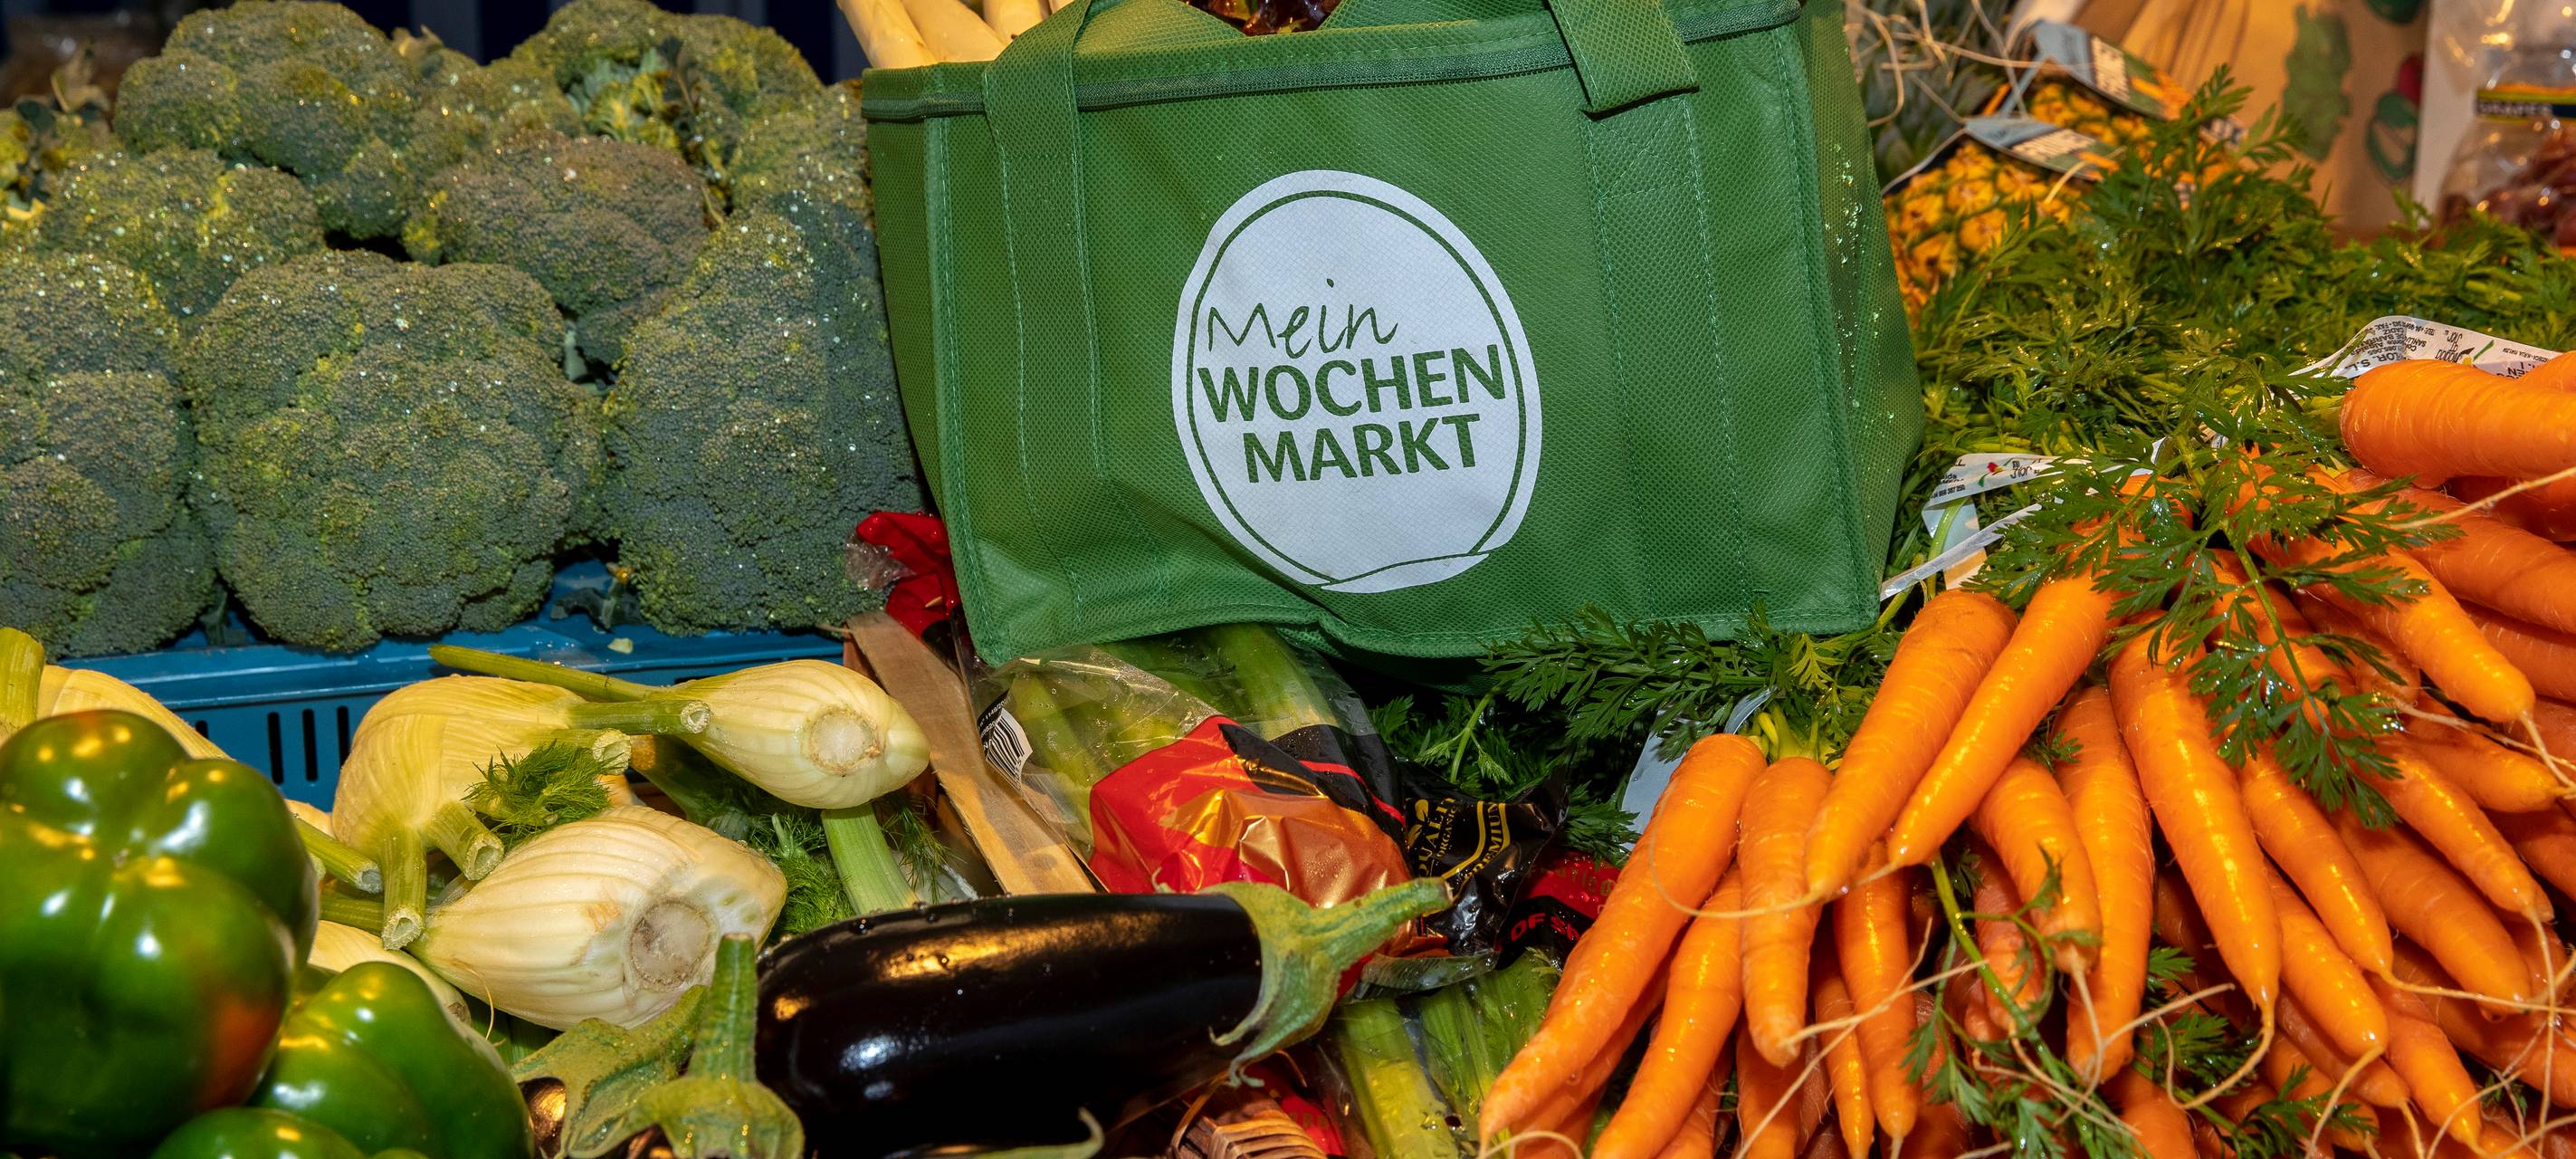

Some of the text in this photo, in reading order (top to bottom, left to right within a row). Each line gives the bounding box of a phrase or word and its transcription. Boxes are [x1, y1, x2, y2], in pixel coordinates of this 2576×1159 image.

[1207, 277, 1398, 359] Mein
[1197, 343, 1506, 423] WOCHEN
[1243, 413, 1481, 484] MARKT
[1511, 912, 1547, 942] OF
